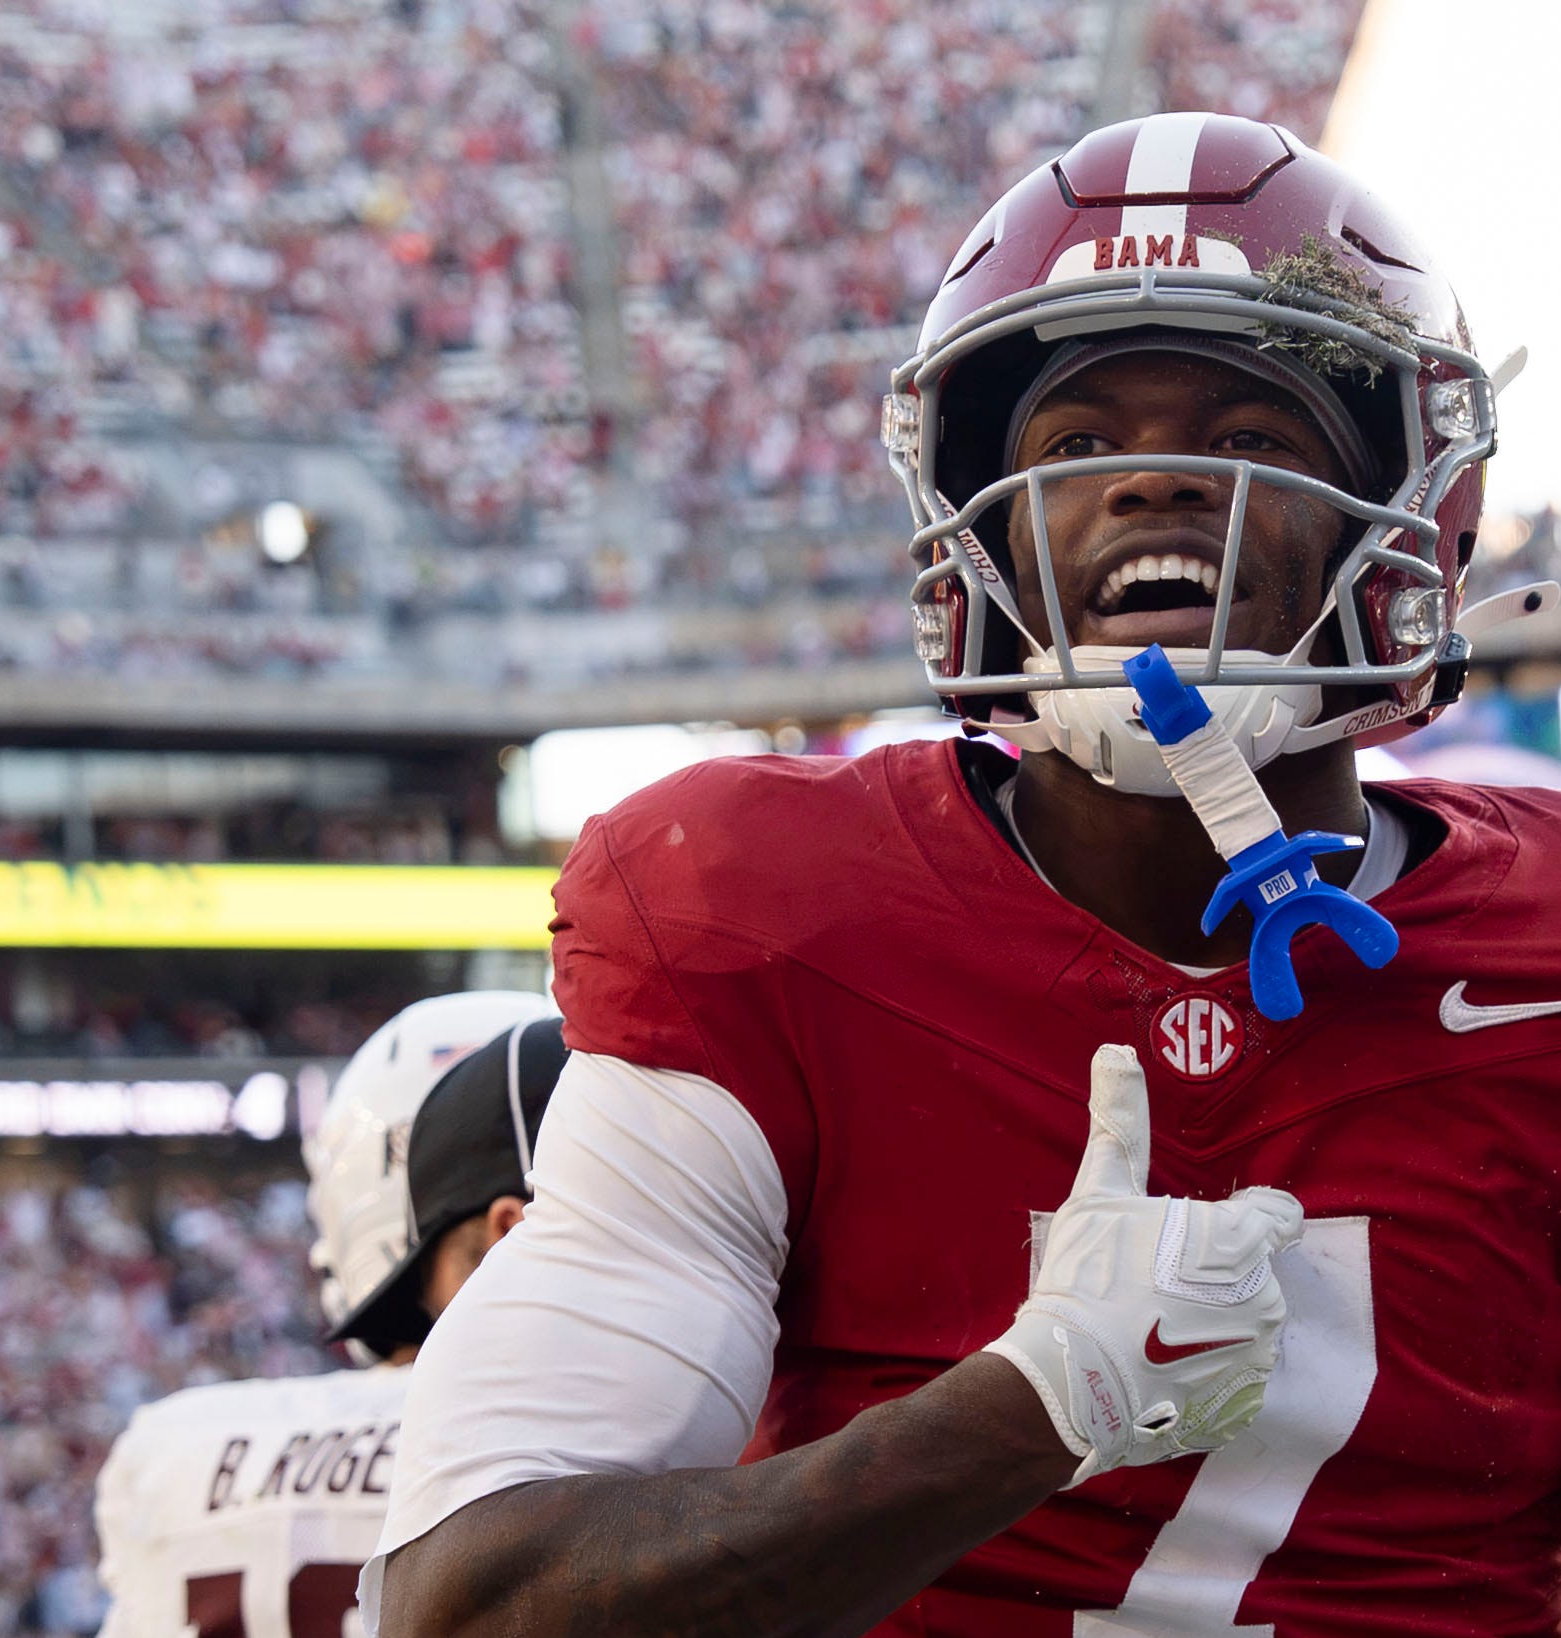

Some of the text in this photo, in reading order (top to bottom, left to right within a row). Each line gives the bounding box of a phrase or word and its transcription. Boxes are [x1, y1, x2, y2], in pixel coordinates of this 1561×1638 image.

[1093, 234, 1200, 271] BAMA
[1342, 689, 1423, 736] CRIMSON
[1264, 874, 1291, 899] PRO
[1159, 998, 1235, 1075] SEC
